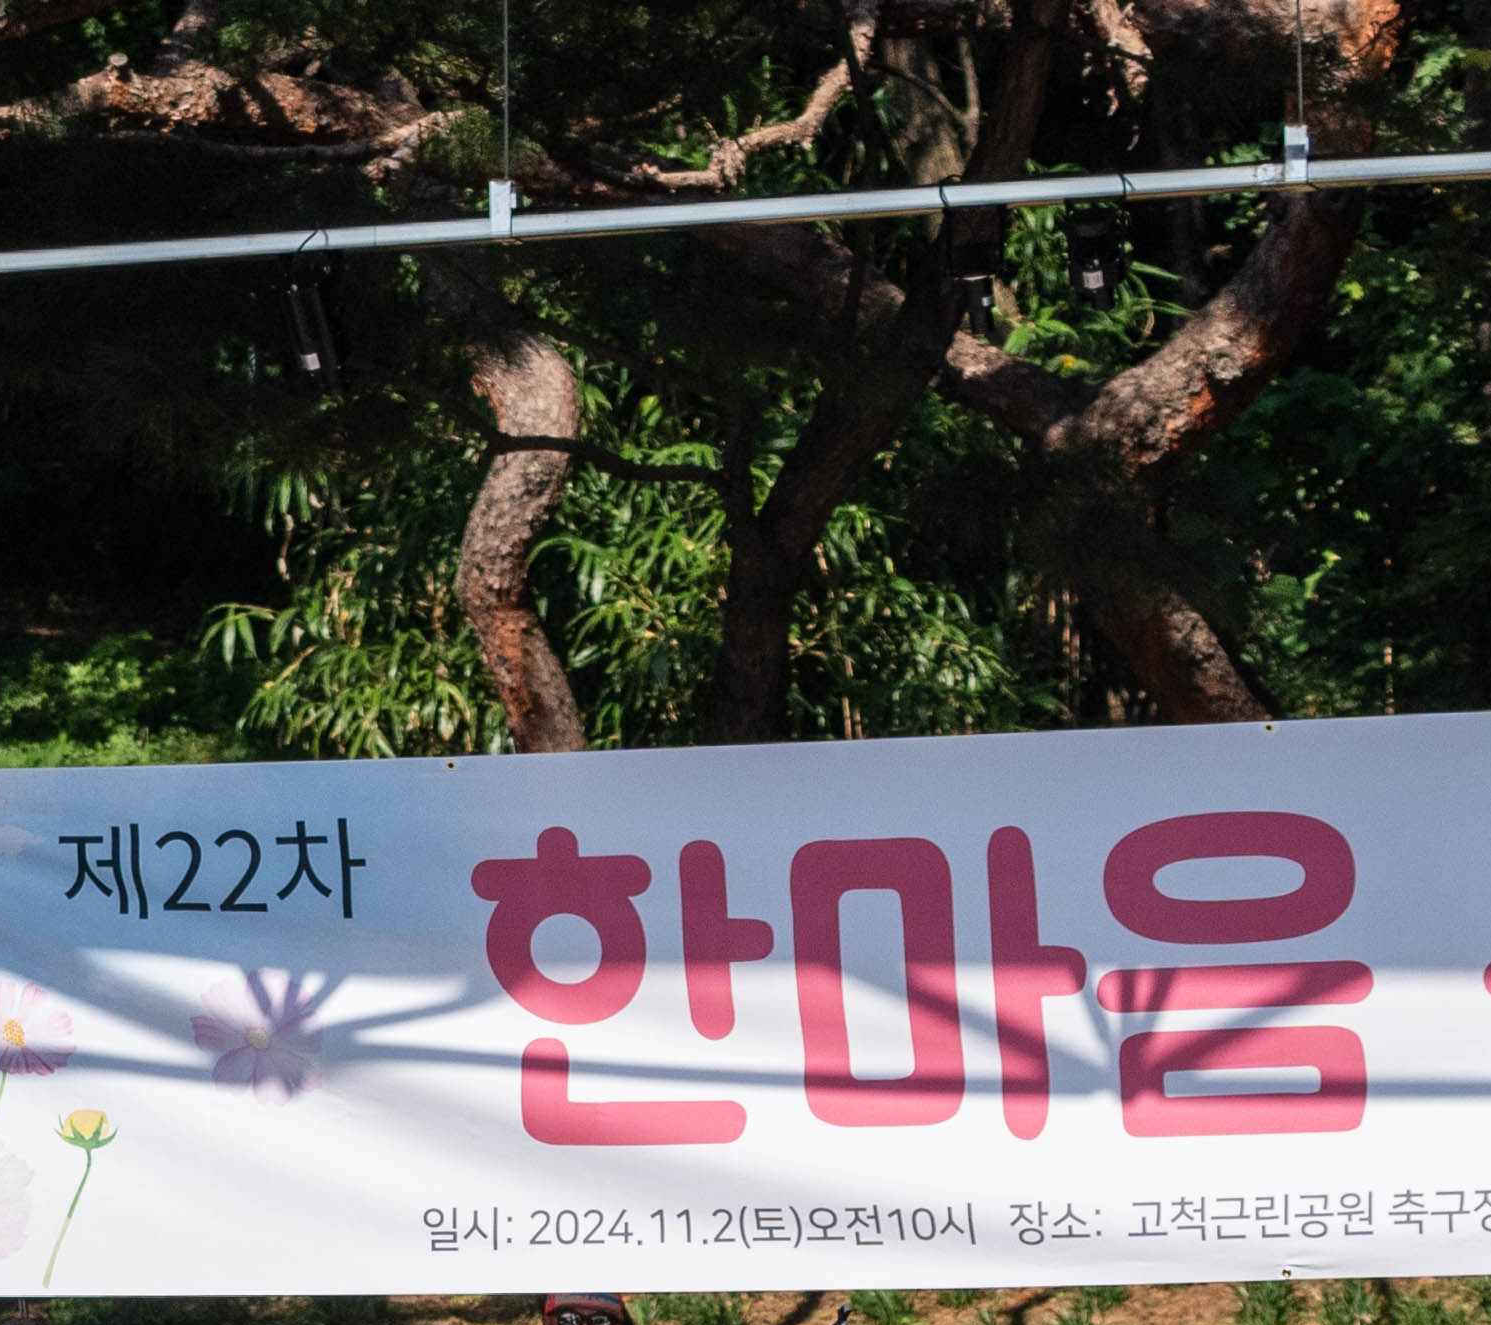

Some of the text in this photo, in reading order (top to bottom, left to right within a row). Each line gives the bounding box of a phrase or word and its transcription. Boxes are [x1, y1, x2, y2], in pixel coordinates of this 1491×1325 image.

[59, 818, 367, 919] 제22차
[472, 812, 1373, 1146] 한마음
[423, 1207, 514, 1251] 일시:
[530, 1202, 977, 1248] 2024.11.2(토)오전10시
[1010, 1201, 1102, 1245] 장소:
[1128, 1191, 1373, 1242] 고척근린공원
